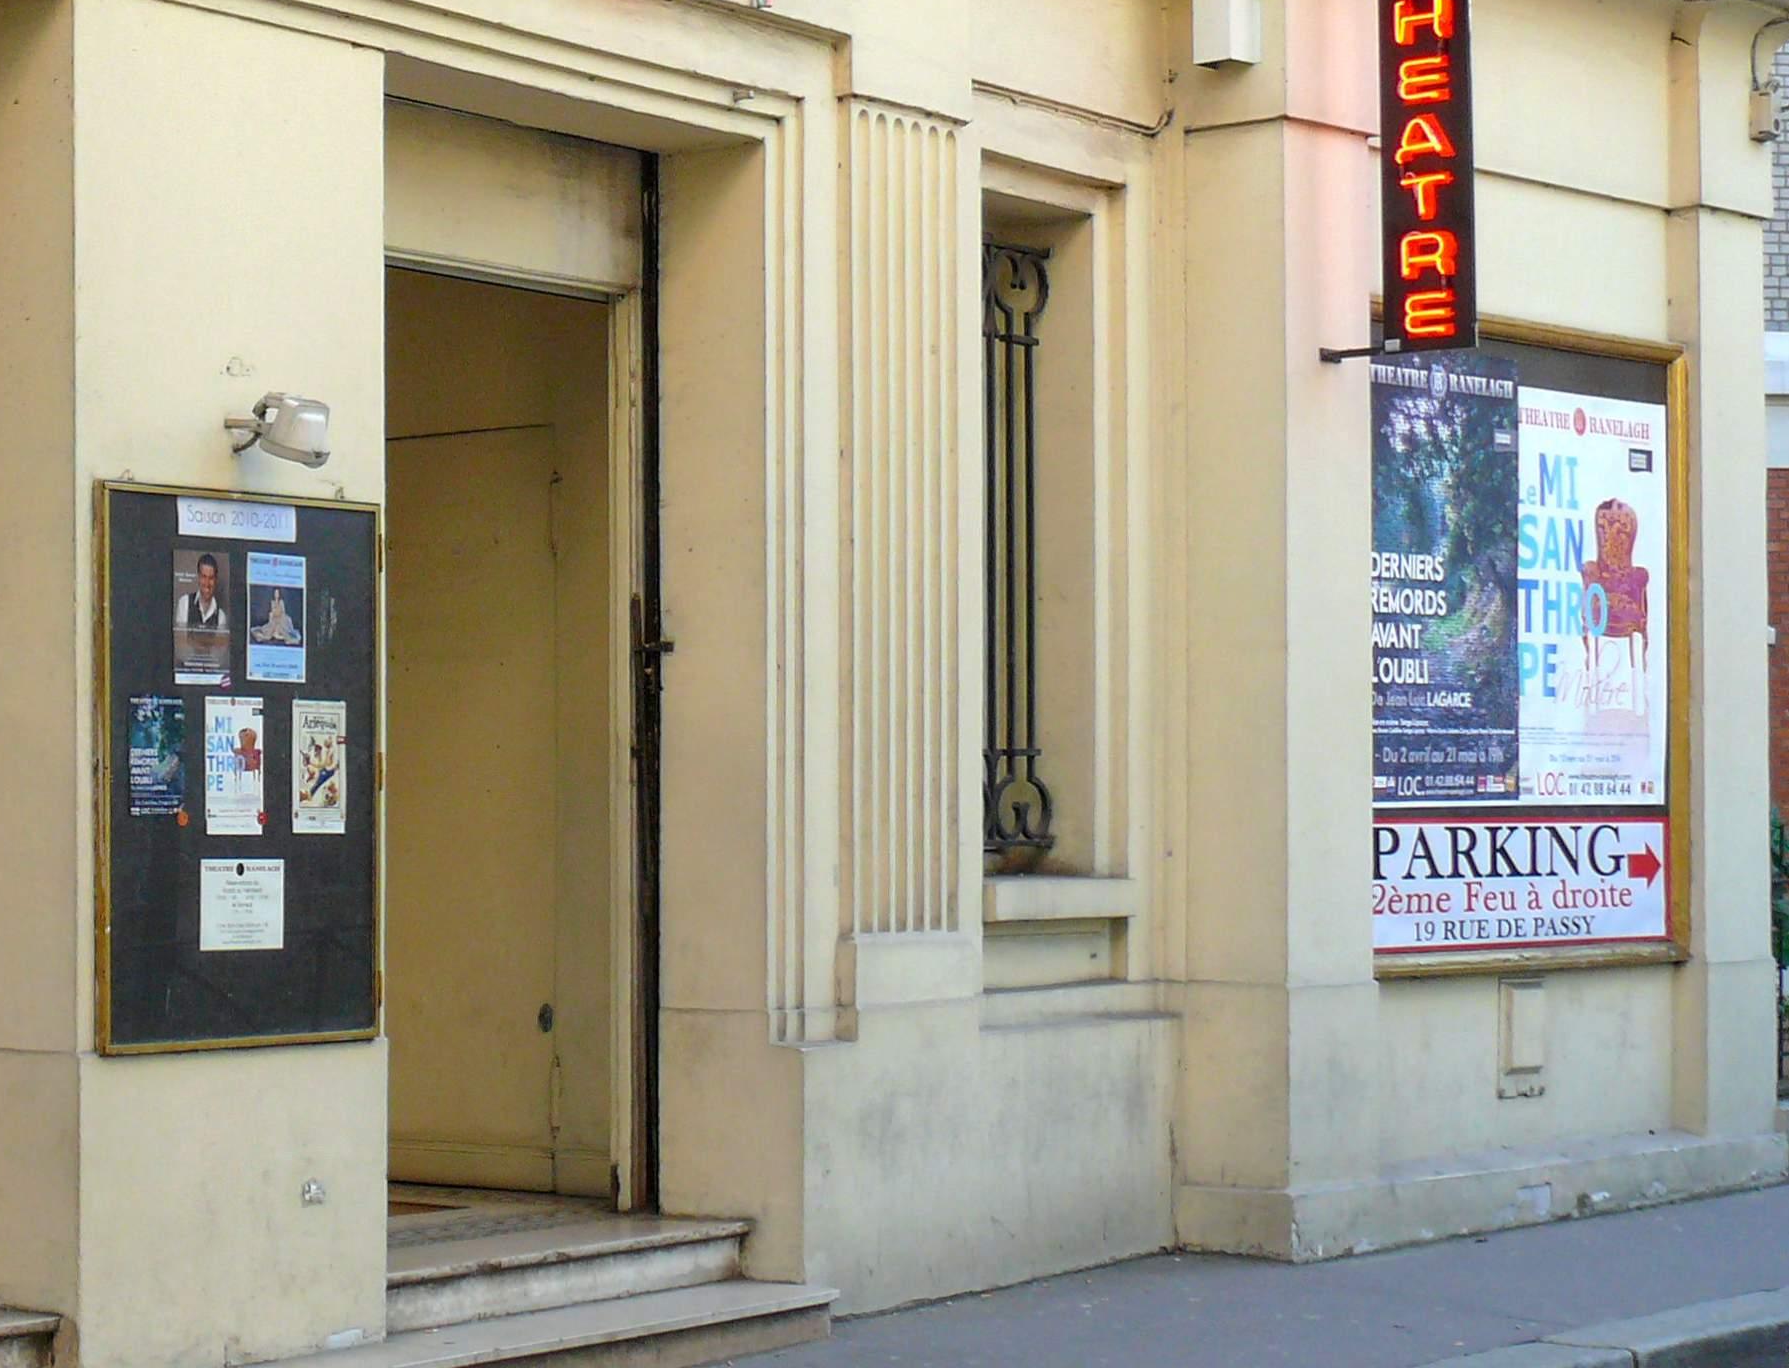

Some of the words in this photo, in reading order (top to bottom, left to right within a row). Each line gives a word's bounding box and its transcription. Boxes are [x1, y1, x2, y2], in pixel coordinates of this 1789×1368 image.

[1370, 364, 1428, 389] THEATRE
[1449, 374, 1513, 399] RANELAGH
[1518, 407, 1571, 430] THEATRE
[1588, 416, 1650, 440] RANELAGH
[1539, 452, 1579, 510] MI
[187, 504, 226, 525] Saison
[1518, 514, 1584, 572] SAN
[1371, 552, 1445, 581] DERNIERS
[1372, 586, 1447, 616] REMORDS
[1518, 578, 1609, 637] THRO
[1372, 621, 1422, 650] AVANT
[1518, 642, 1558, 698] PE
[1427, 691, 1472, 708] LAGARCE
[214, 715, 232, 734] MI
[207, 735, 234, 753] SAN
[207, 754, 245, 772] THRO
[207, 773, 224, 792] PE
[1397, 775, 1425, 797] LOC.
[1373, 824, 1625, 880] PARKING
[1373, 883, 1451, 915] 2ème
[1462, 881, 1517, 913] Feu
[1527, 882, 1543, 910] à
[1552, 877, 1633, 909] droite
[1414, 920, 1435, 942] 19
[1443, 919, 1490, 940] RUE
[1497, 918, 1527, 938] DE
[1533, 915, 1596, 937] PASSY
